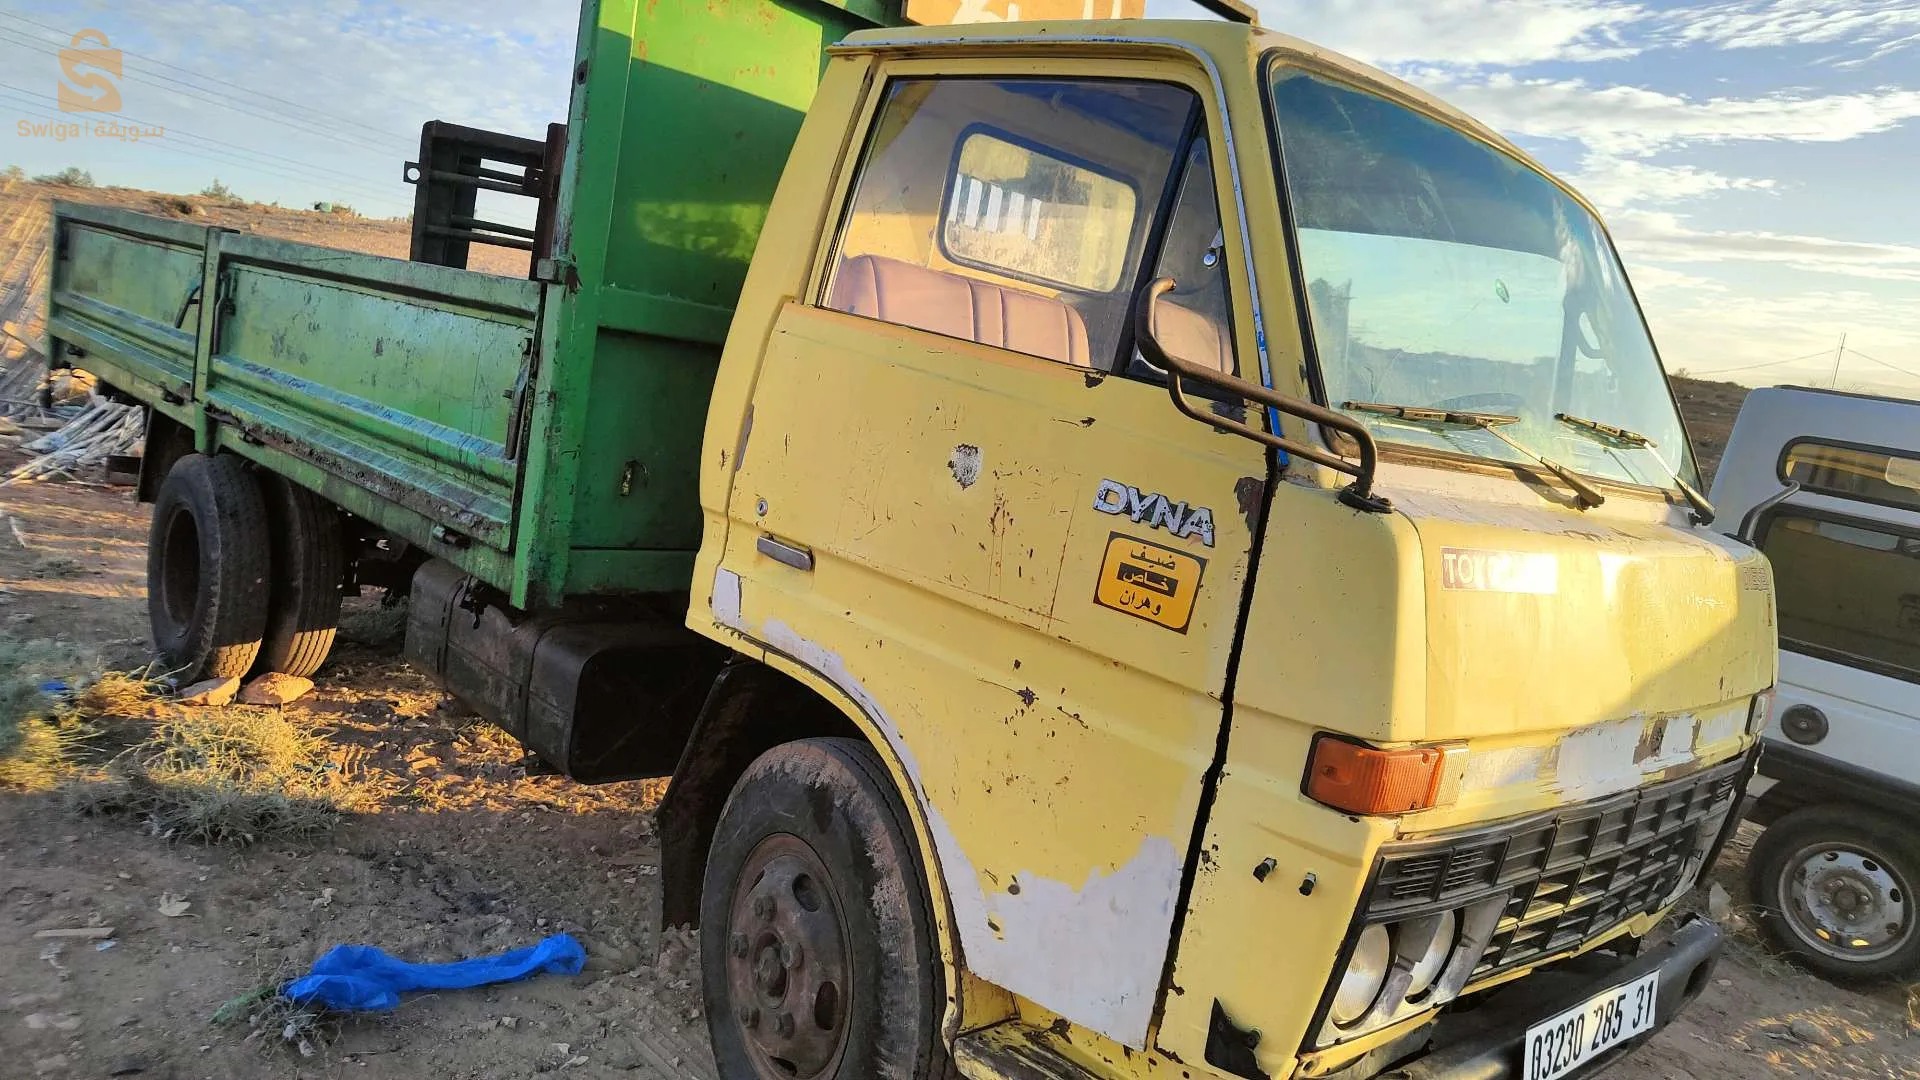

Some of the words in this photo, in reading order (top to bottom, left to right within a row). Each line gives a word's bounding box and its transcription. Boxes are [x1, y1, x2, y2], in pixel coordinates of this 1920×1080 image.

[1093, 478, 1216, 548] DYNA
[1130, 545, 1176, 570] ضيف
[1122, 571, 1169, 591] خاص
[1119, 590, 1162, 616] وهران
[1531, 1013, 1585, 1080] 03230
[1591, 994, 1626, 1051] 285
[1632, 980, 1655, 1029] 31
